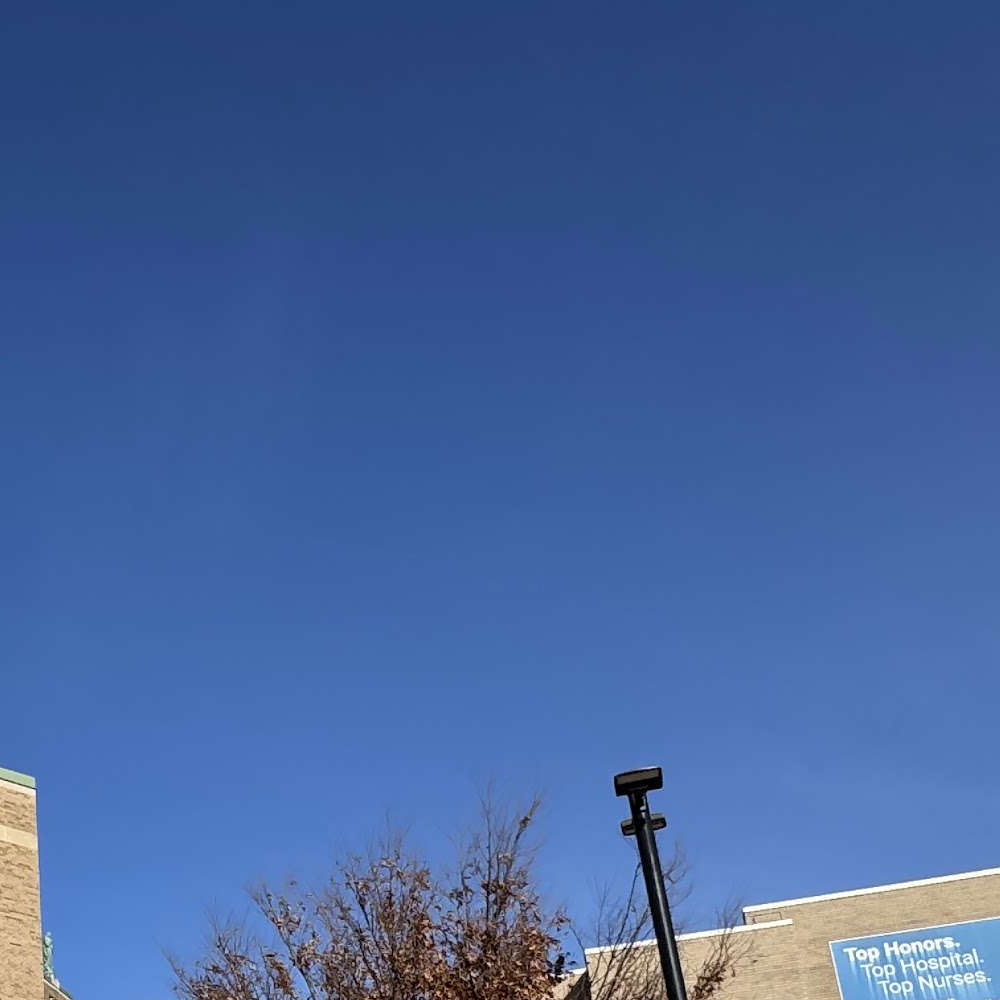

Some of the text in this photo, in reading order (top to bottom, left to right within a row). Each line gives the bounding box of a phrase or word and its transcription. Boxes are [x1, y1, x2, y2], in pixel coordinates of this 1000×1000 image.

[843, 936, 961, 963] Top Honors.
[860, 948, 985, 982] Top Hospital.
[877, 970, 992, 997] Top Nurses.
